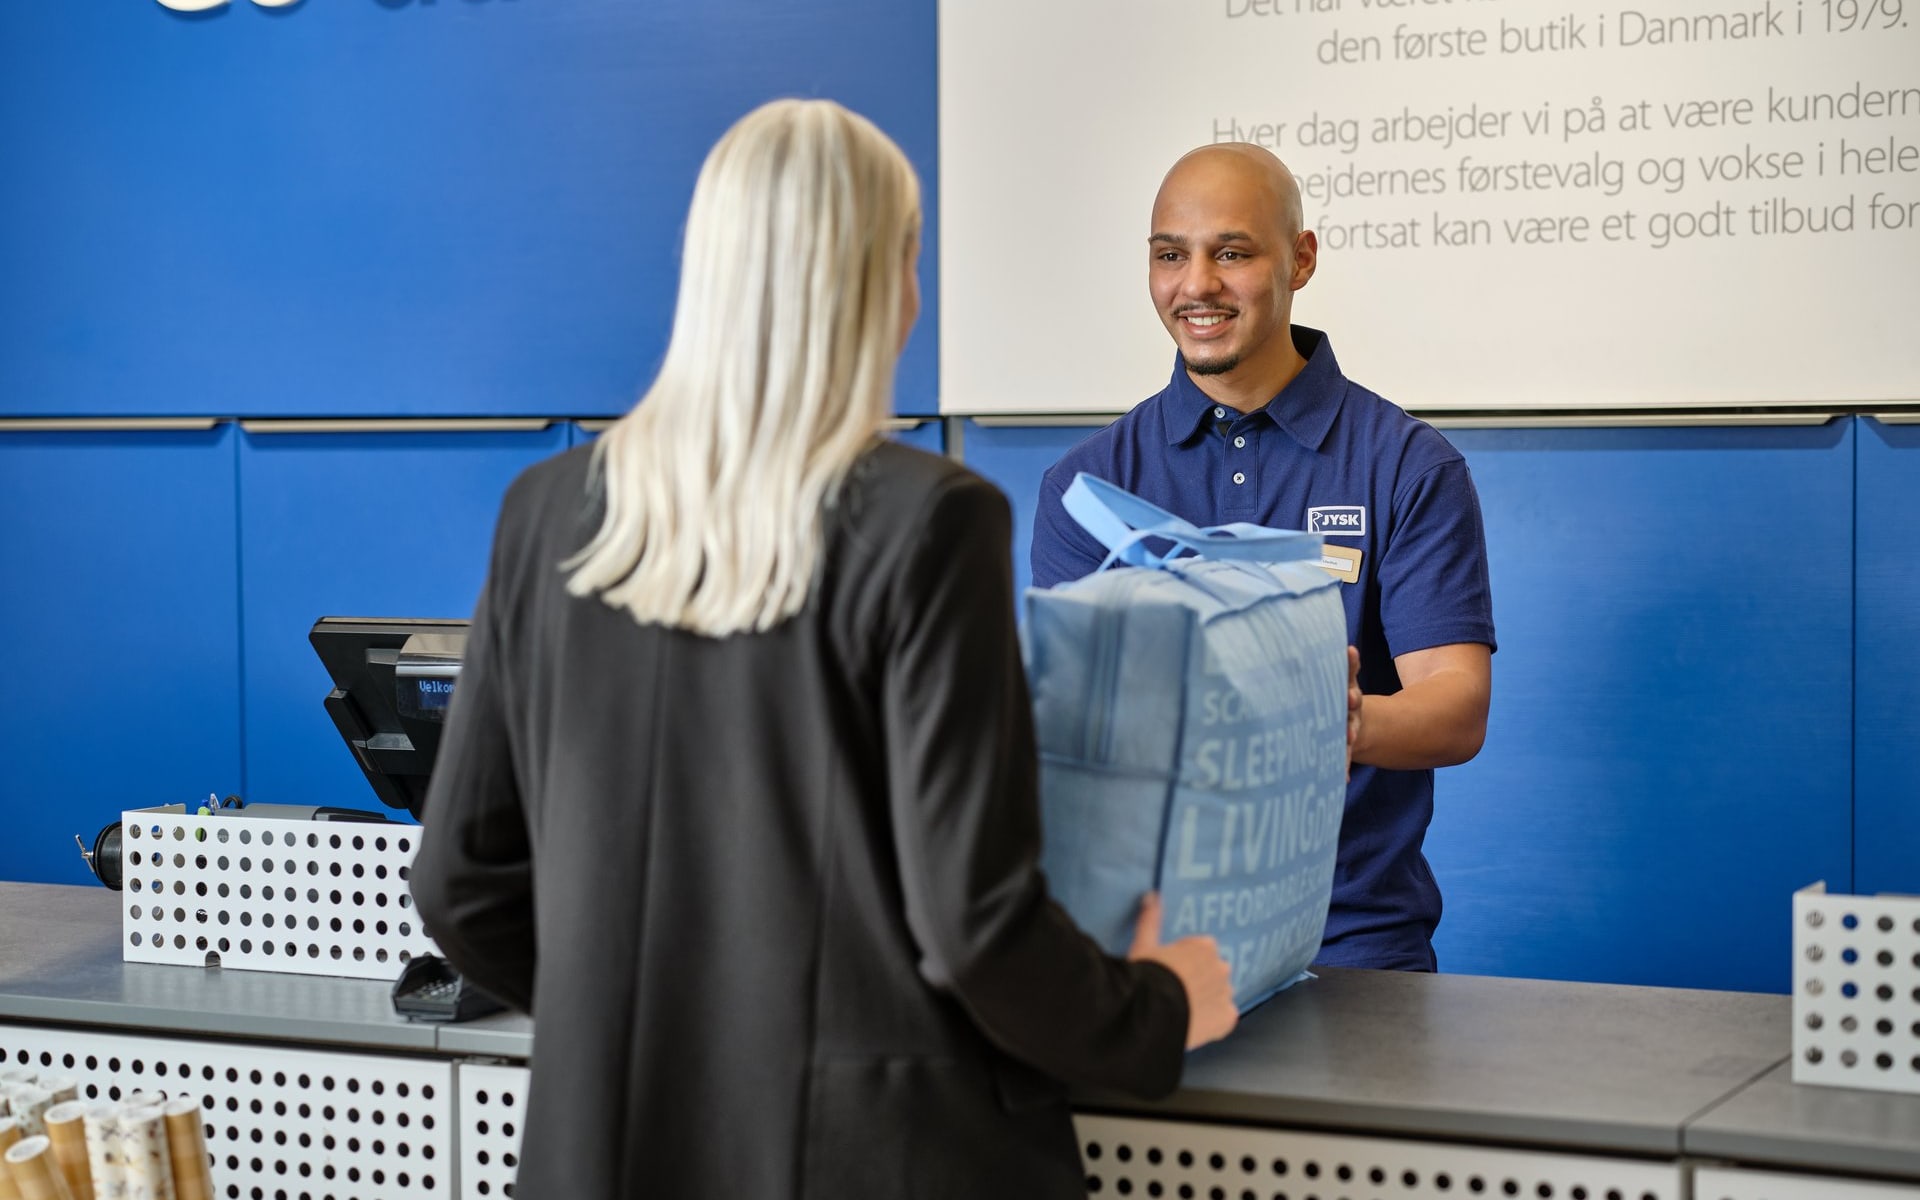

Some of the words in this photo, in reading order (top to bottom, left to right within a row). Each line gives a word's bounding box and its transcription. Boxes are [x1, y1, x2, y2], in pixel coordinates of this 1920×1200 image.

[1317, 29, 1381, 64] den
[1394, 24, 1487, 59] første
[1501, 13, 1587, 53] butik
[1600, 14, 1604, 48] i
[1620, 0, 1784, 46] Danmark
[1797, 0, 1802, 35] i
[1213, 117, 1287, 148] Hver
[1296, 112, 1359, 154] dag
[1372, 103, 1512, 149] arbejder
[1522, 102, 1550, 138] vi
[1564, 96, 1605, 143] på
[1619, 100, 1652, 131] at
[1663, 98, 1753, 128] være
[1458, 151, 1624, 196] førstevalg
[1638, 157, 1685, 193] og
[1699, 143, 1804, 181] vokse
[1818, 142, 1824, 176] i
[1841, 136, 1919, 175] hele
[1316, 214, 1421, 250] fortsat
[1433, 211, 1490, 247] kan
[1504, 216, 1589, 244] være
[1602, 210, 1637, 241] et
[1649, 200, 1736, 248] godt
[1748, 195, 1854, 235] tilbud
[1868, 192, 1920, 230] for
[1322, 514, 1359, 526] JYSK
[1193, 719, 1316, 790] SLEEPING
[1177, 783, 1316, 880] LIVING
